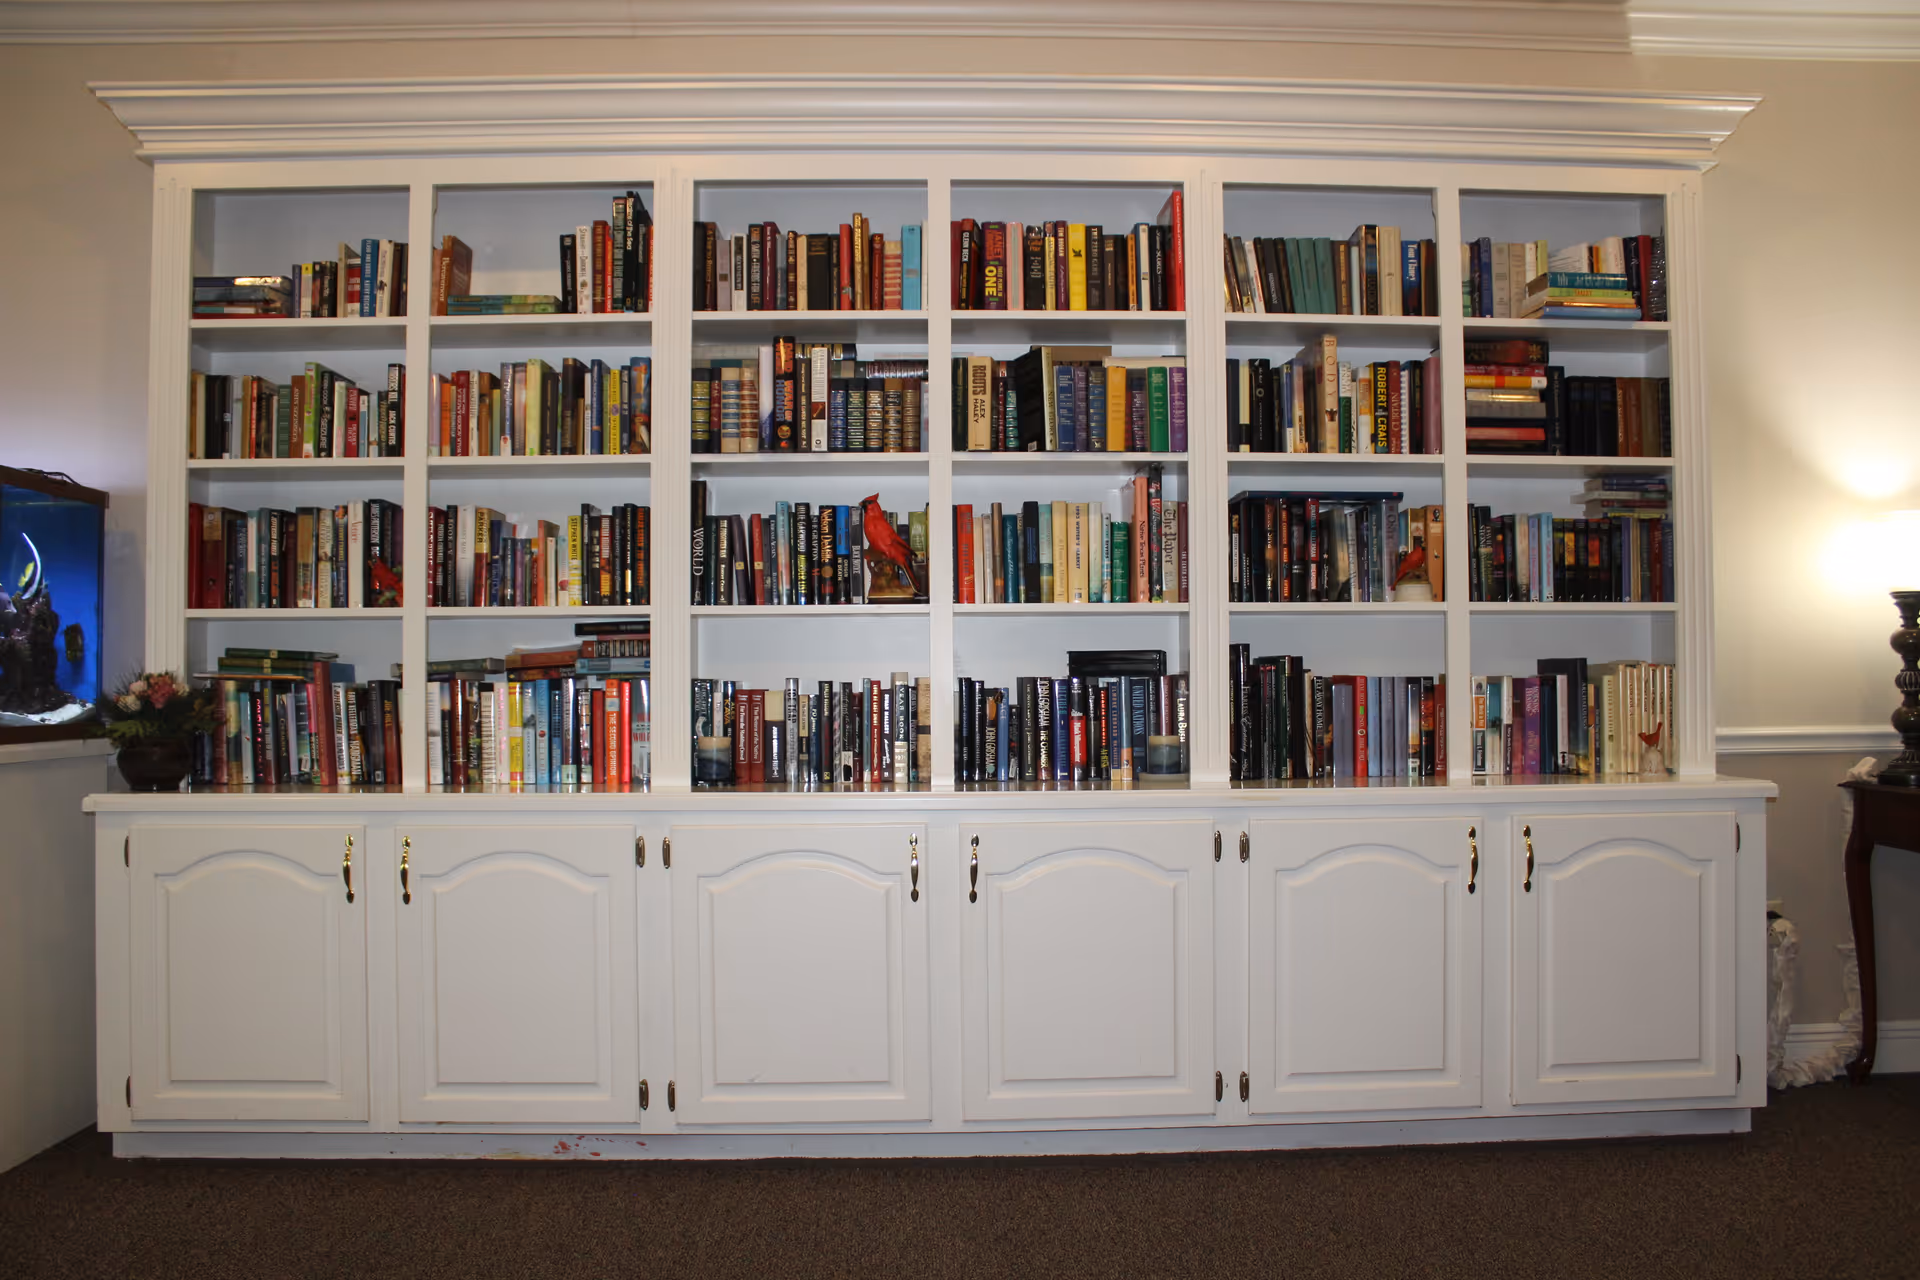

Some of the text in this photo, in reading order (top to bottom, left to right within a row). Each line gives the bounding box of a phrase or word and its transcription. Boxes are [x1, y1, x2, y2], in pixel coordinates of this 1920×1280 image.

[993, 231, 1002, 258] JANET
[1407, 244, 1418, 281] Tom Clancy
[985, 266, 997, 296] ONE
[972, 365, 987, 395] ROOTS
[1326, 340, 1336, 398] BODY
[776, 380, 784, 422] HONOR
[784, 380, 794, 409] WAR
[1378, 367, 1387, 447] ROBERT CRAIS
[1391, 392, 1400, 430] CURTAIN
[371, 518, 380, 543] PATTERSON
[798, 522, 806, 552] GARWOOD
[820, 509, 833, 563] Nelson DeMille
[1163, 509, 1177, 565] The Paper
[693, 528, 704, 576] WORLD
[798, 581, 806, 593] LIST
[334, 689, 342, 716] JEFFERSON
[384, 700, 392, 712] JOE
[1133, 685, 1145, 736] UNITED NATIONS
[1316, 692, 1324, 708] AWAY
[335, 717, 343, 734] PARKER
[986, 727, 996, 742] JOHN
[1038, 680, 1050, 768] JOHN GRISHAM THE CHAMBER
[1177, 698, 1187, 742] LAURA BUSH
[1316, 710, 1324, 730] HOME
[350, 740, 362, 775] HANGMAN
